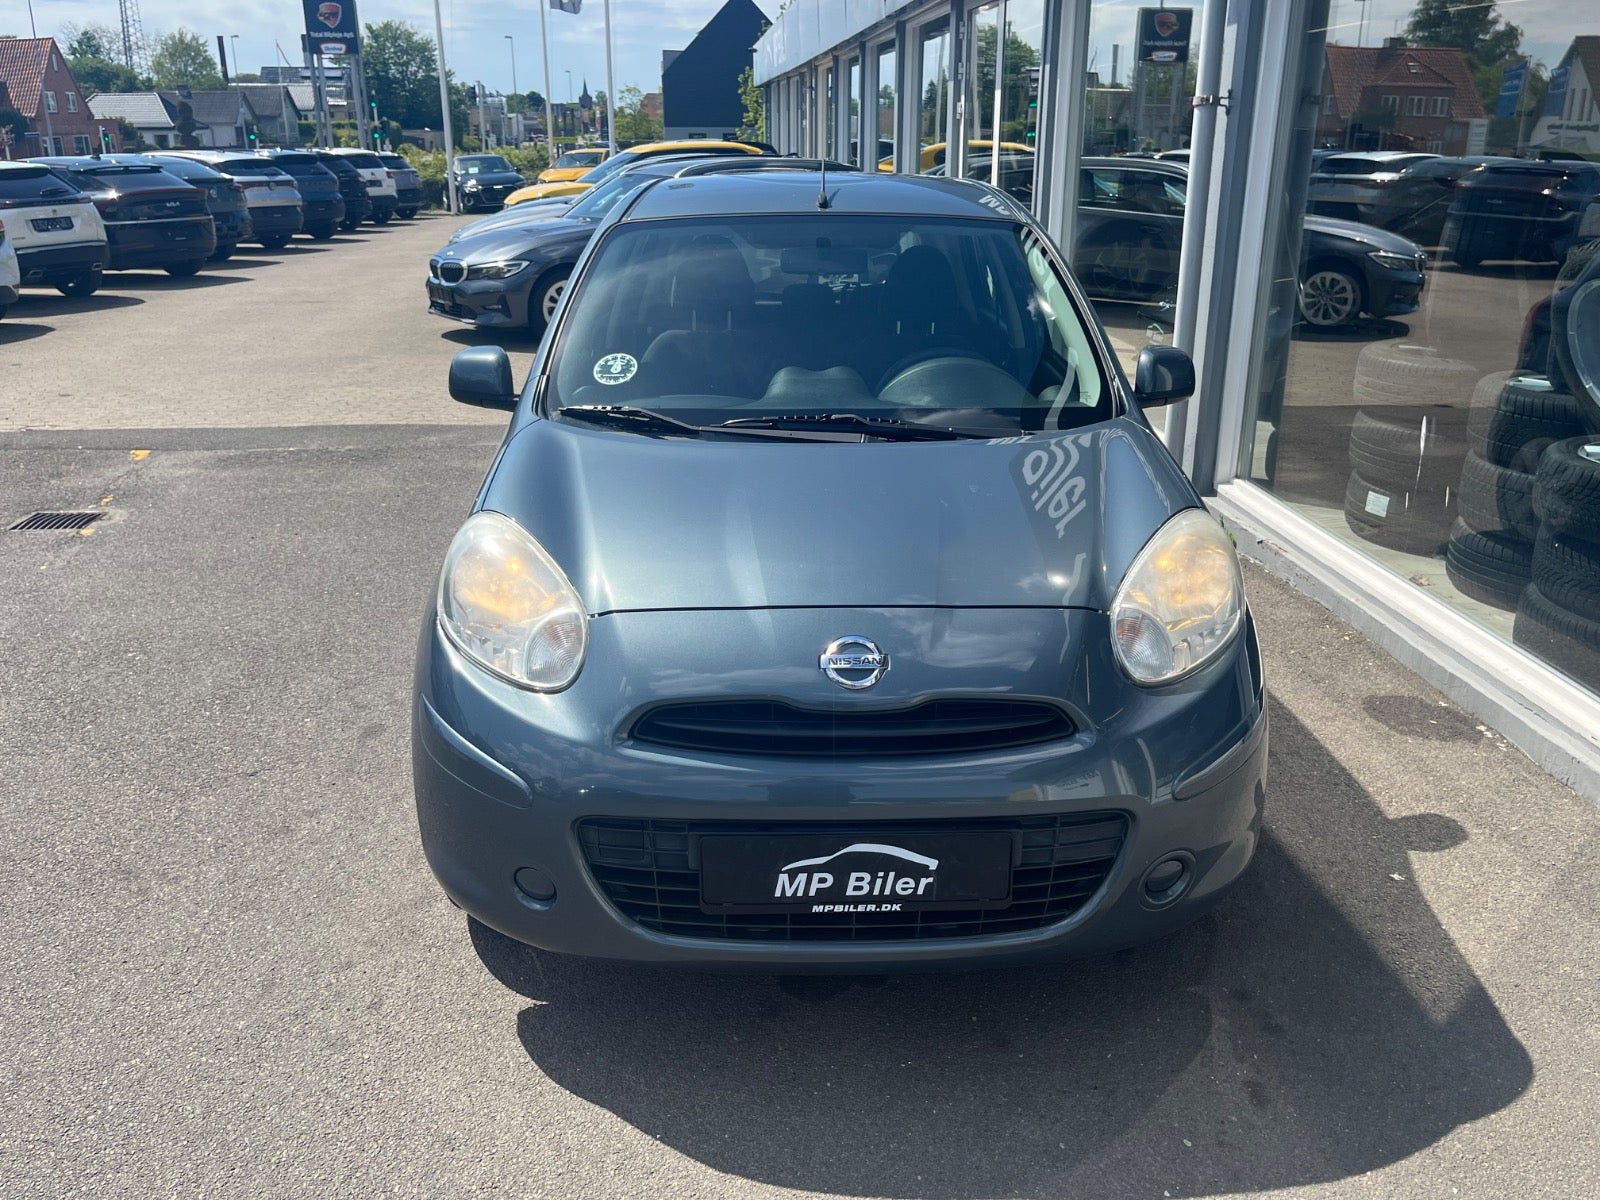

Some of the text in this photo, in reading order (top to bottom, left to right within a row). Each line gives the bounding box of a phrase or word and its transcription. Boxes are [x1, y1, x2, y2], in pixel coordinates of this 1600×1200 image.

[828, 656, 881, 665] NISSAN
[774, 871, 934, 897] MP Biler
[812, 903, 902, 913] MPBILER.DK
